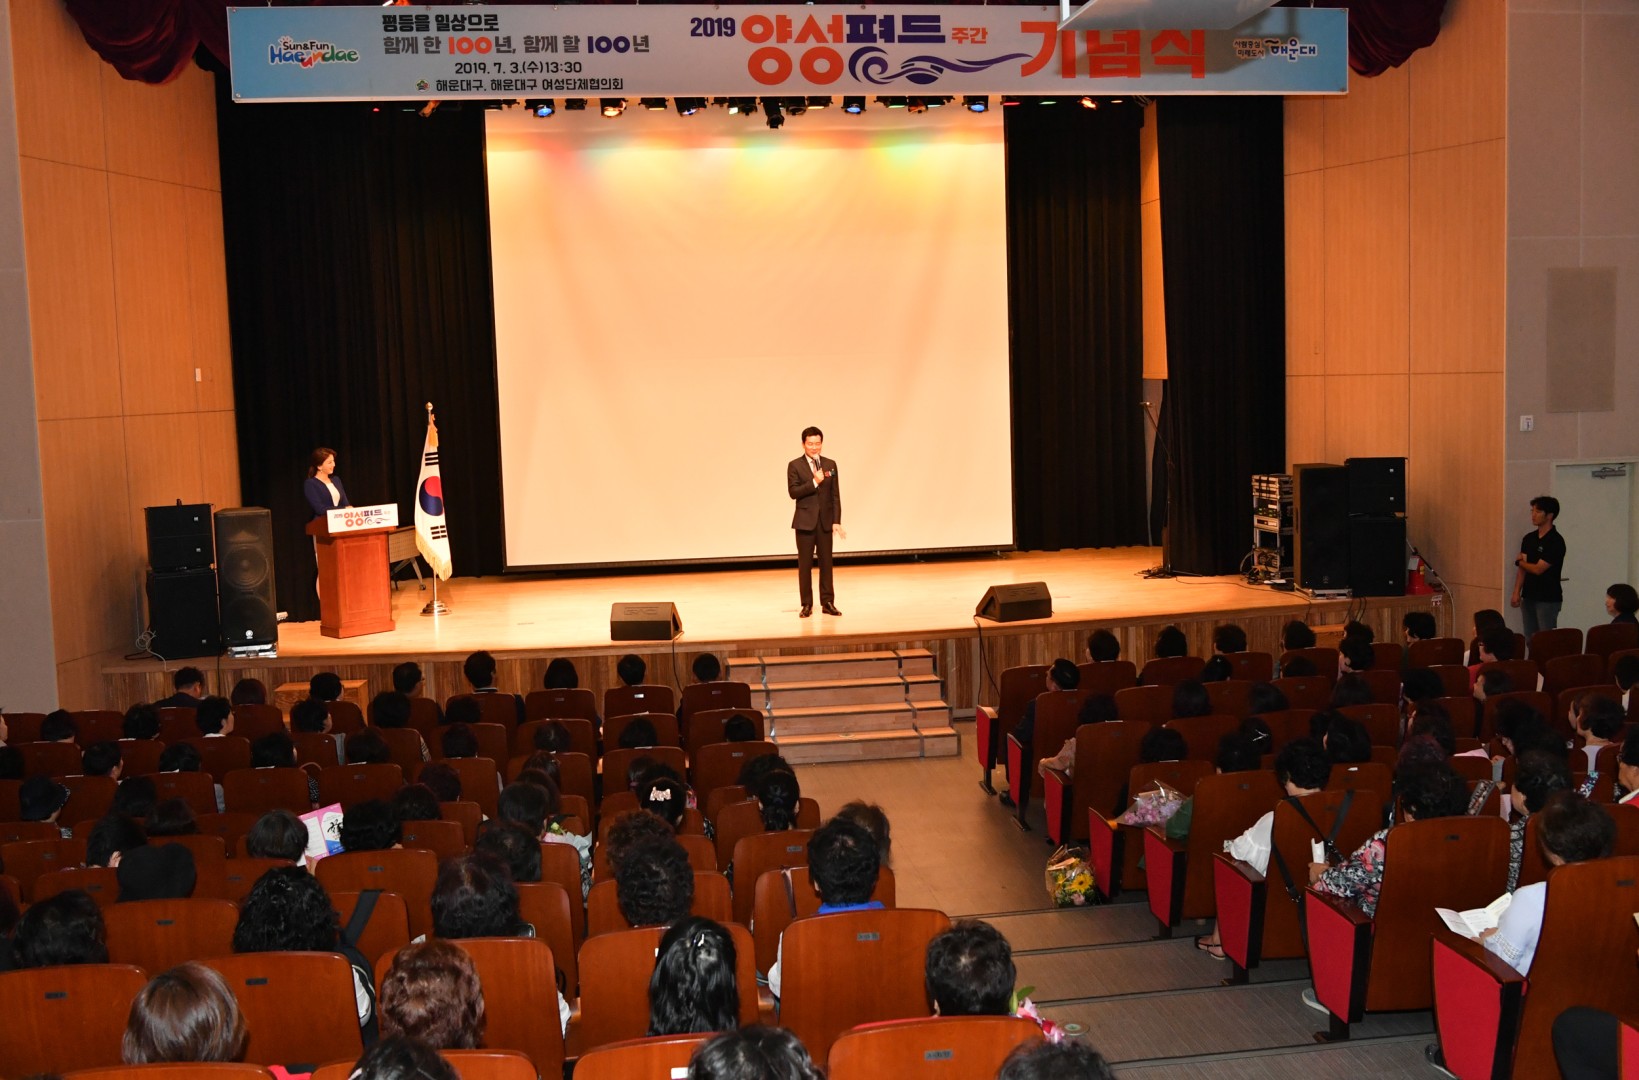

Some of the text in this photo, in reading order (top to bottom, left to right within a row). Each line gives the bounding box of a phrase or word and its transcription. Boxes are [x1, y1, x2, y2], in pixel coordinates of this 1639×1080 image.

[382, 14, 499, 32] 평등을 일상으로
[282, 41, 329, 51] Sun&Fun
[383, 35, 649, 55] 함께 한 100년, 함께 할 100년
[690, 14, 1206, 86] 2019 양성평등 주간 기념식
[1265, 38, 1316, 60] 해운대
[455, 62, 490, 74] 2019.
[493, 62, 506, 74] 7.
[490, 79, 537, 91] 해운대구
[542, 78, 623, 91] 여성단체협의회
